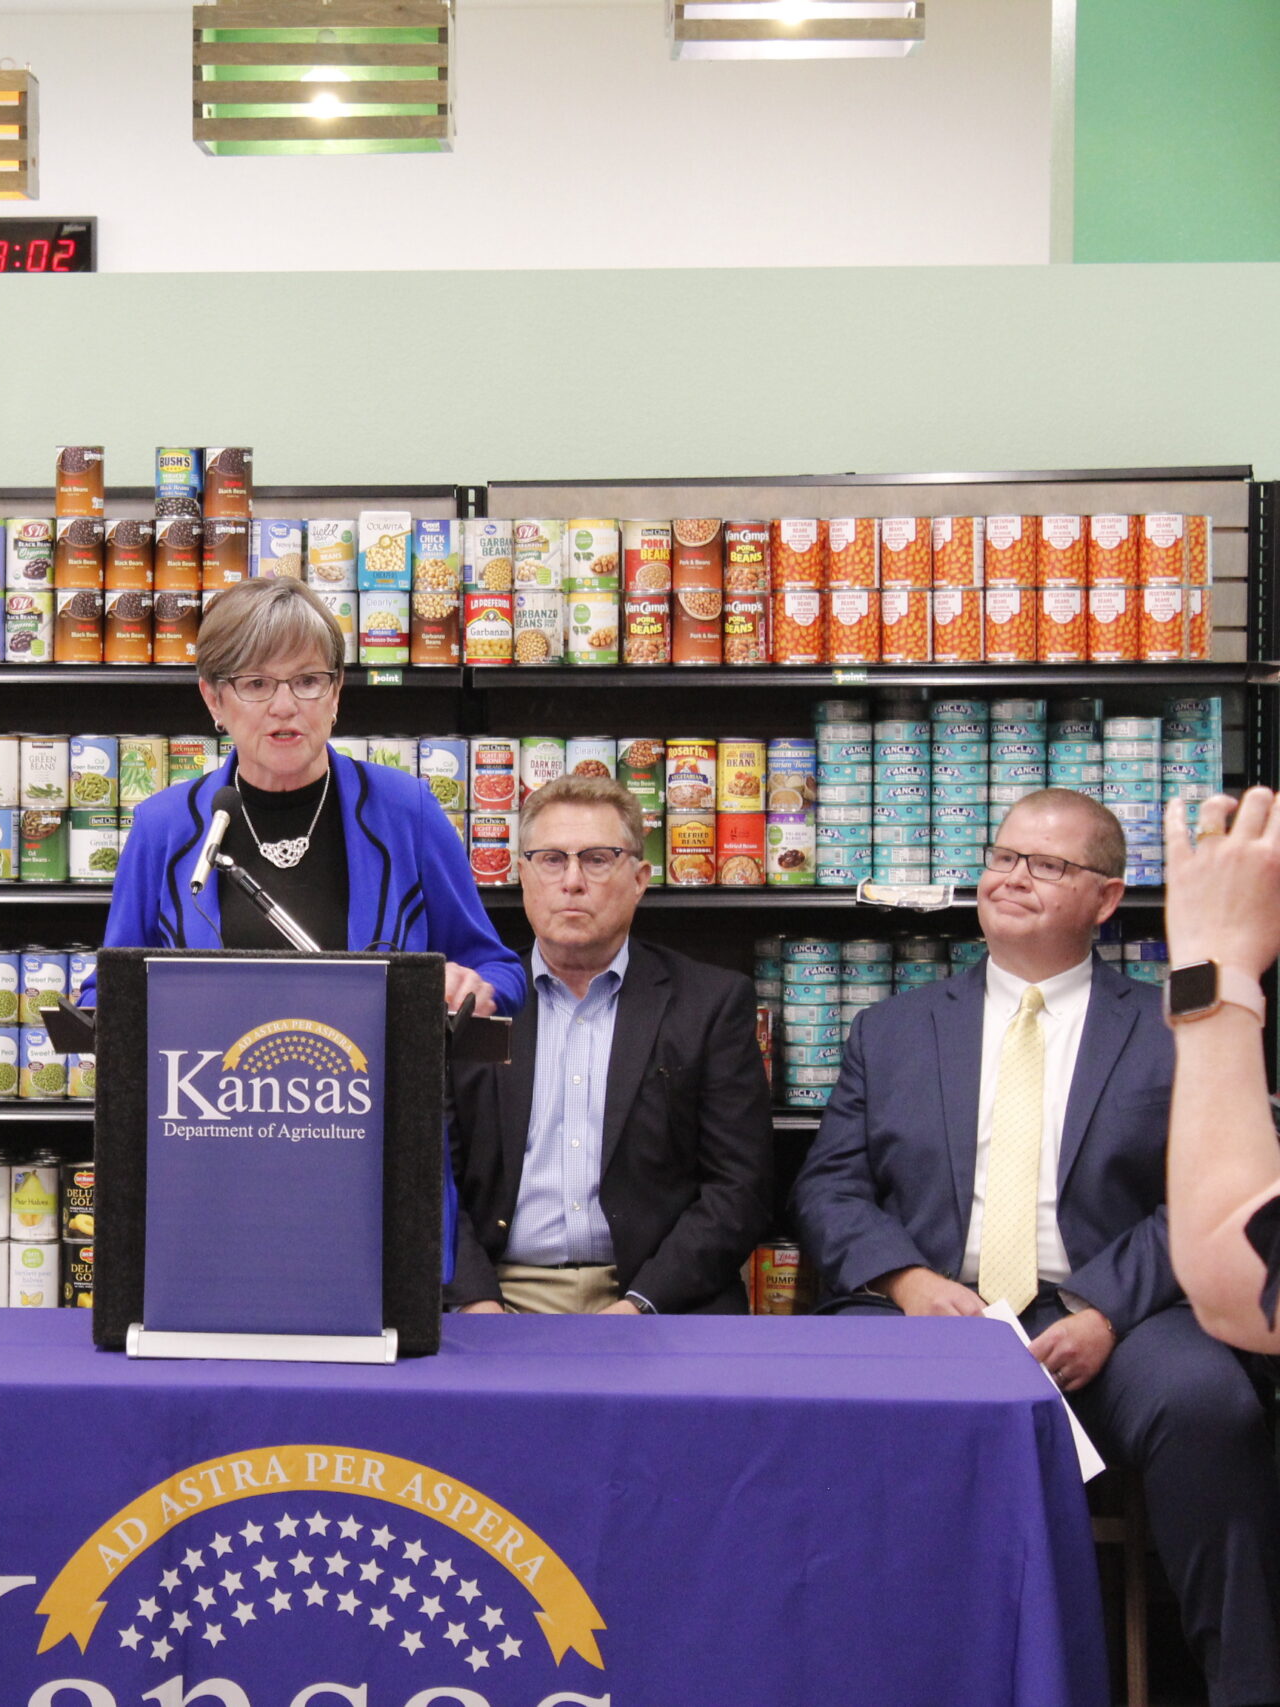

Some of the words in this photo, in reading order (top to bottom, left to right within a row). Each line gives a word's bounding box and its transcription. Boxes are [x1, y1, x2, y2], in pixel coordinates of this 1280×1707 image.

[159, 456, 190, 468] BUSH'S
[420, 535, 445, 543] CHICK
[641, 539, 664, 548] PORK
[422, 543, 443, 552] PEAS
[640, 549, 670, 560] BEANS
[730, 552, 762, 562] BEANS
[630, 623, 662, 634] BEANS
[374, 673, 399, 683] point
[530, 760, 549, 770] DARK
[550, 760, 563, 769] RED
[534, 768, 559, 778] KIDNEY
[238, 1035, 252, 1052] AD
[254, 1021, 288, 1043] ASTRA
[291, 1020, 312, 1031] PER
[315, 1023, 353, 1052] ASPERA
[158, 1050, 372, 1120] Kansas
[163, 1121, 253, 1140] Department
[258, 1122, 276, 1138] of
[278, 1124, 365, 1142] Agriculture
[95, 1514, 148, 1575] AD
[157, 1452, 288, 1527] ASTRA
[305, 1452, 385, 1492] PER
[397, 1470, 546, 1585] ASPERA
